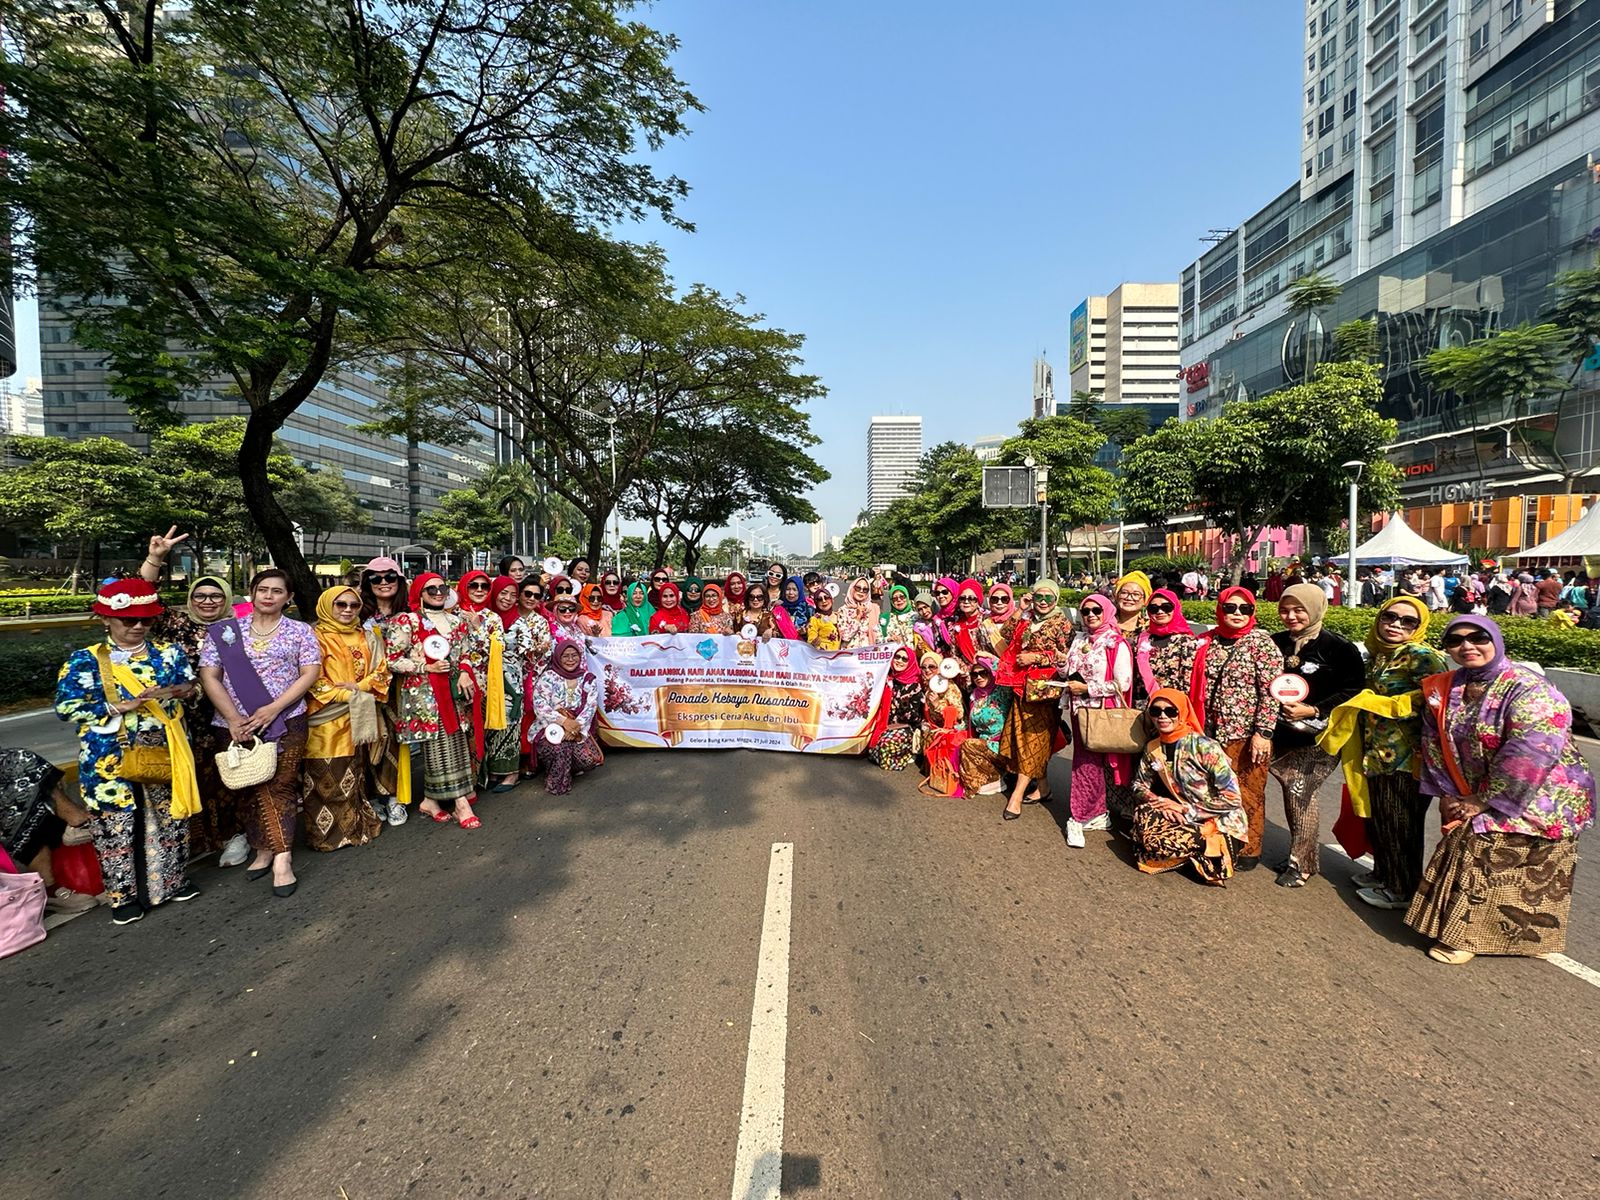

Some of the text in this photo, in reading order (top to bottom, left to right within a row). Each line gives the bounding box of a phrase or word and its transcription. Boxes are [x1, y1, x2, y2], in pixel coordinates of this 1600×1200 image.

[1430, 479, 1496, 503] HOME
[630, 668, 656, 677] DALAM
[668, 692, 810, 708] Parade Kebaya Nusantara
[677, 712, 799, 725] Ekspresi Ceria Aku dan Ibu
